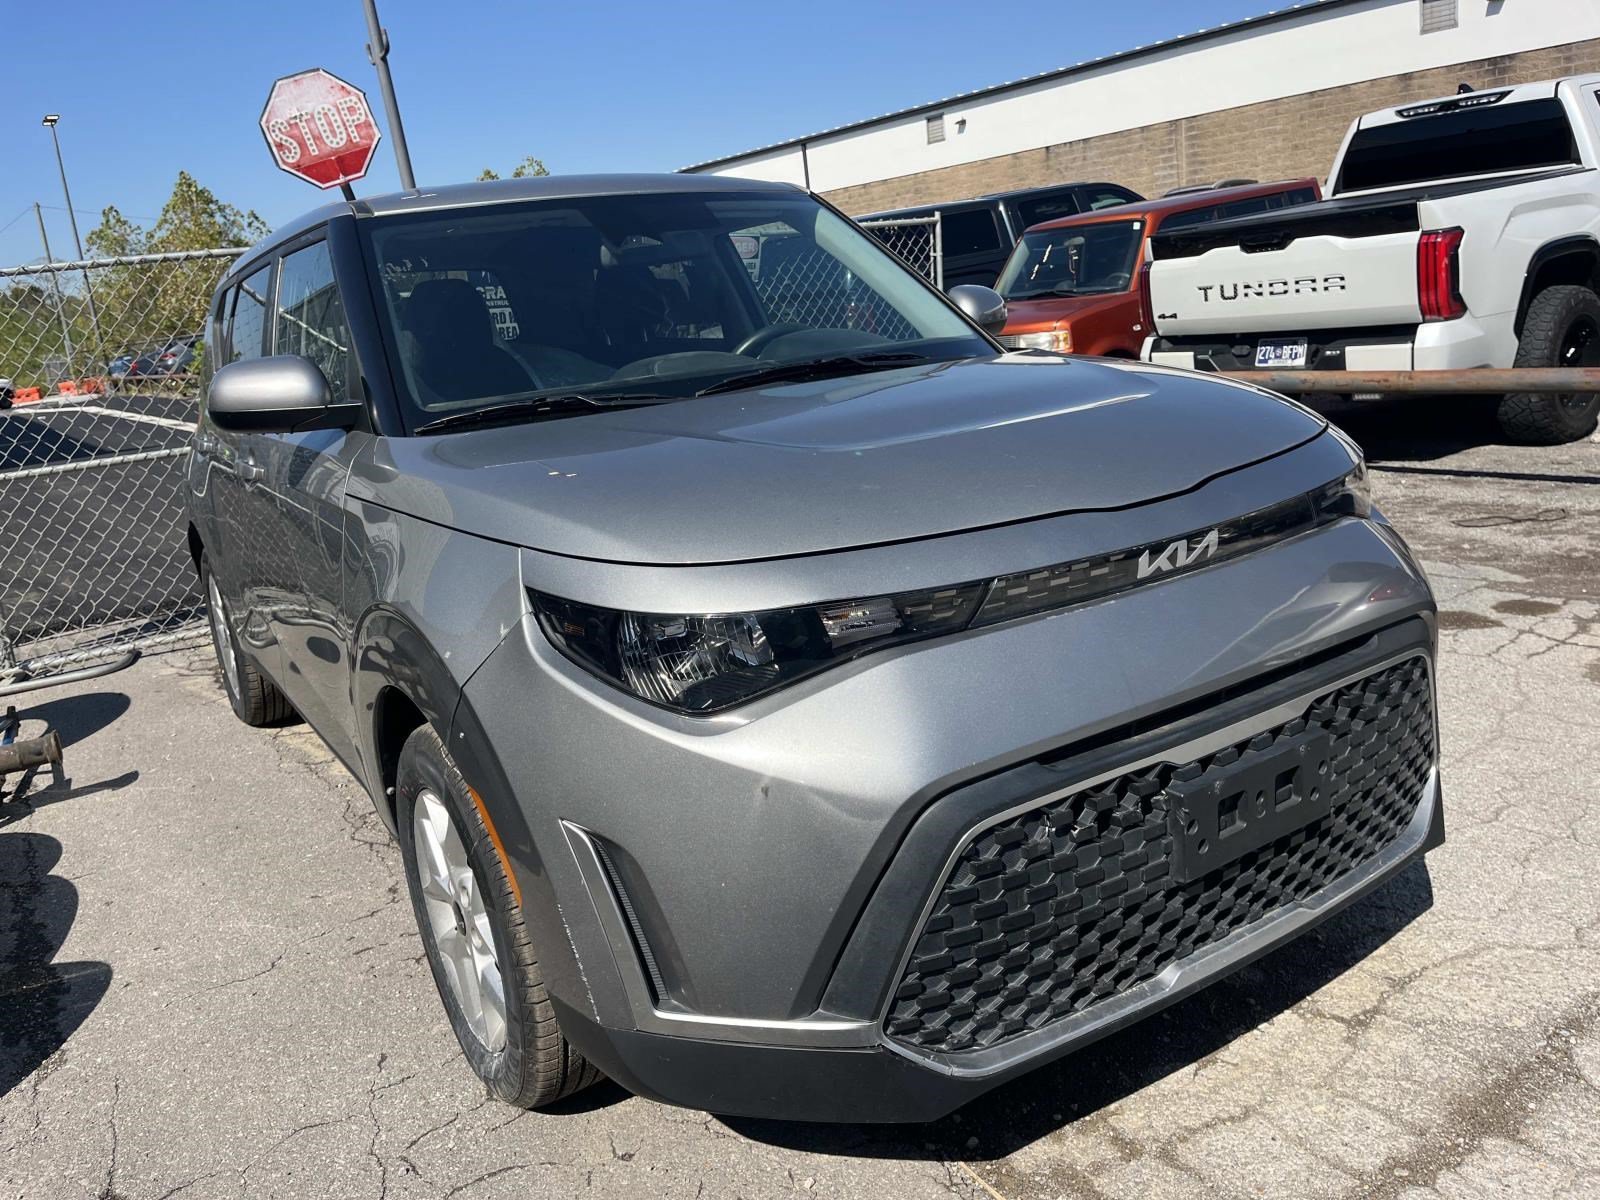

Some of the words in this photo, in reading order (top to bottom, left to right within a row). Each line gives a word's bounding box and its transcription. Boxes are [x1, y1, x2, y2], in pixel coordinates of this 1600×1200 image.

[269, 96, 365, 163] STOP
[1197, 274, 1346, 302] TUNDRA
[1259, 346, 1275, 360] 274
[1137, 528, 1219, 579] KIA
